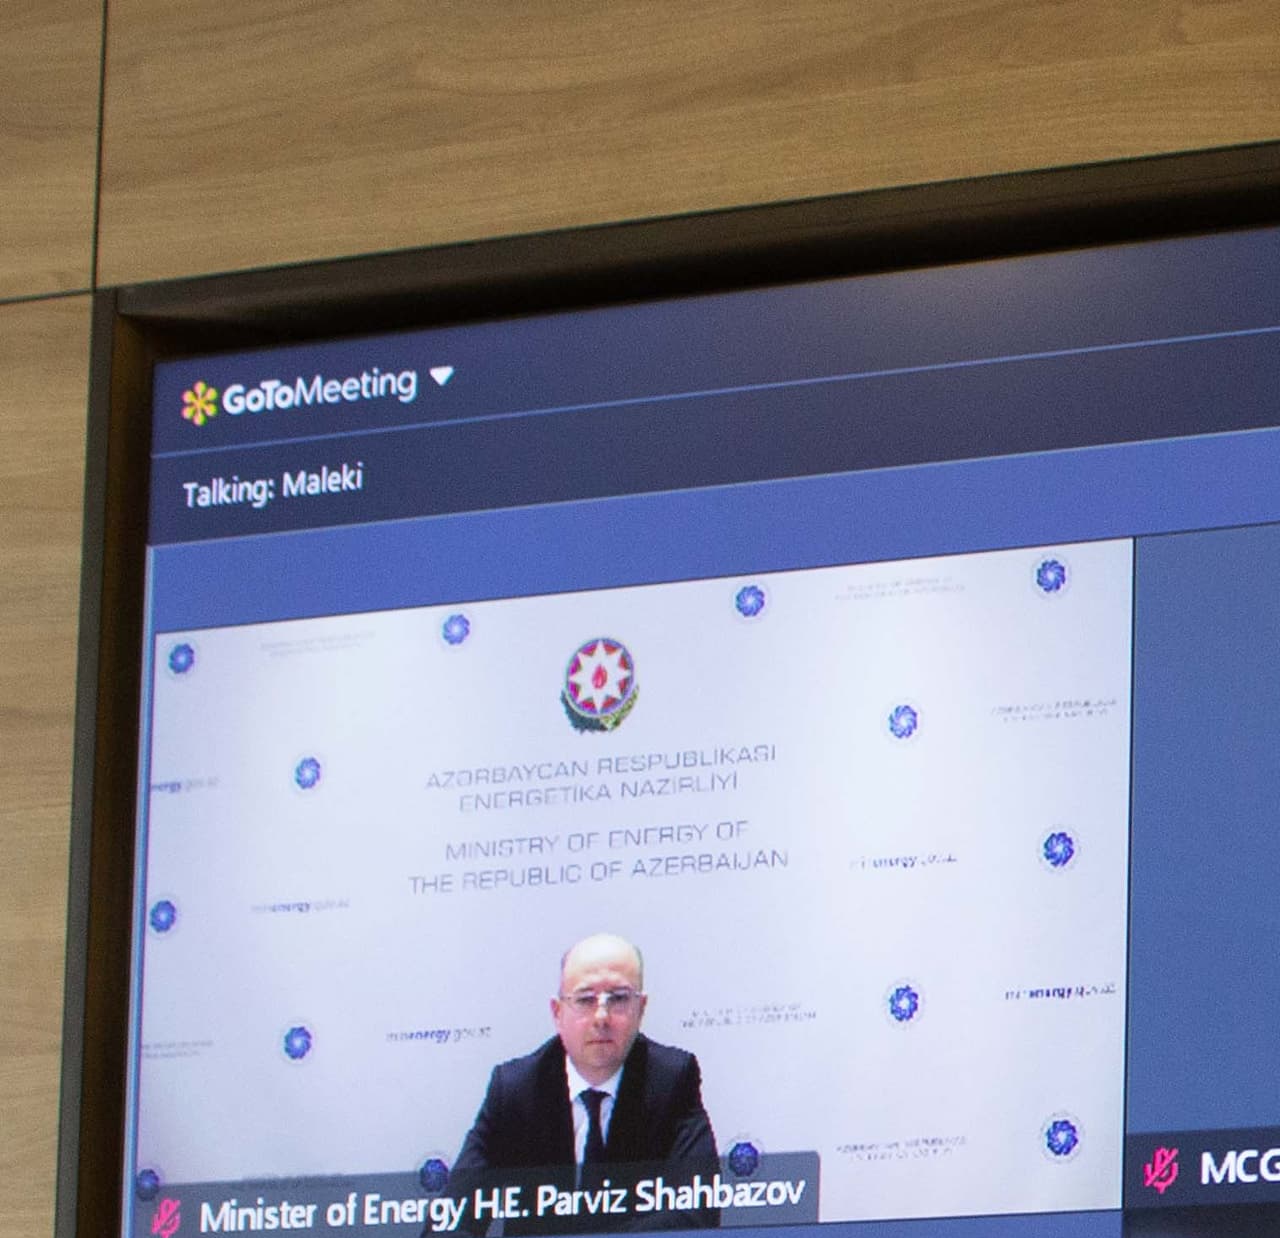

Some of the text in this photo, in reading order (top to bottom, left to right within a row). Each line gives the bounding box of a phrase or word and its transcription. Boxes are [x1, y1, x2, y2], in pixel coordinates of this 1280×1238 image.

[222, 366, 418, 416] GoToMeeting
[183, 461, 364, 509] Talking: Maleki
[446, 820, 749, 862] MINISTRY OF ENERGY OF
[408, 849, 789, 895] THE REPUBLIC OF AZERBAIJAN
[200, 1174, 807, 1233] Minister of Energy H.E. Parviz Shahbazov
